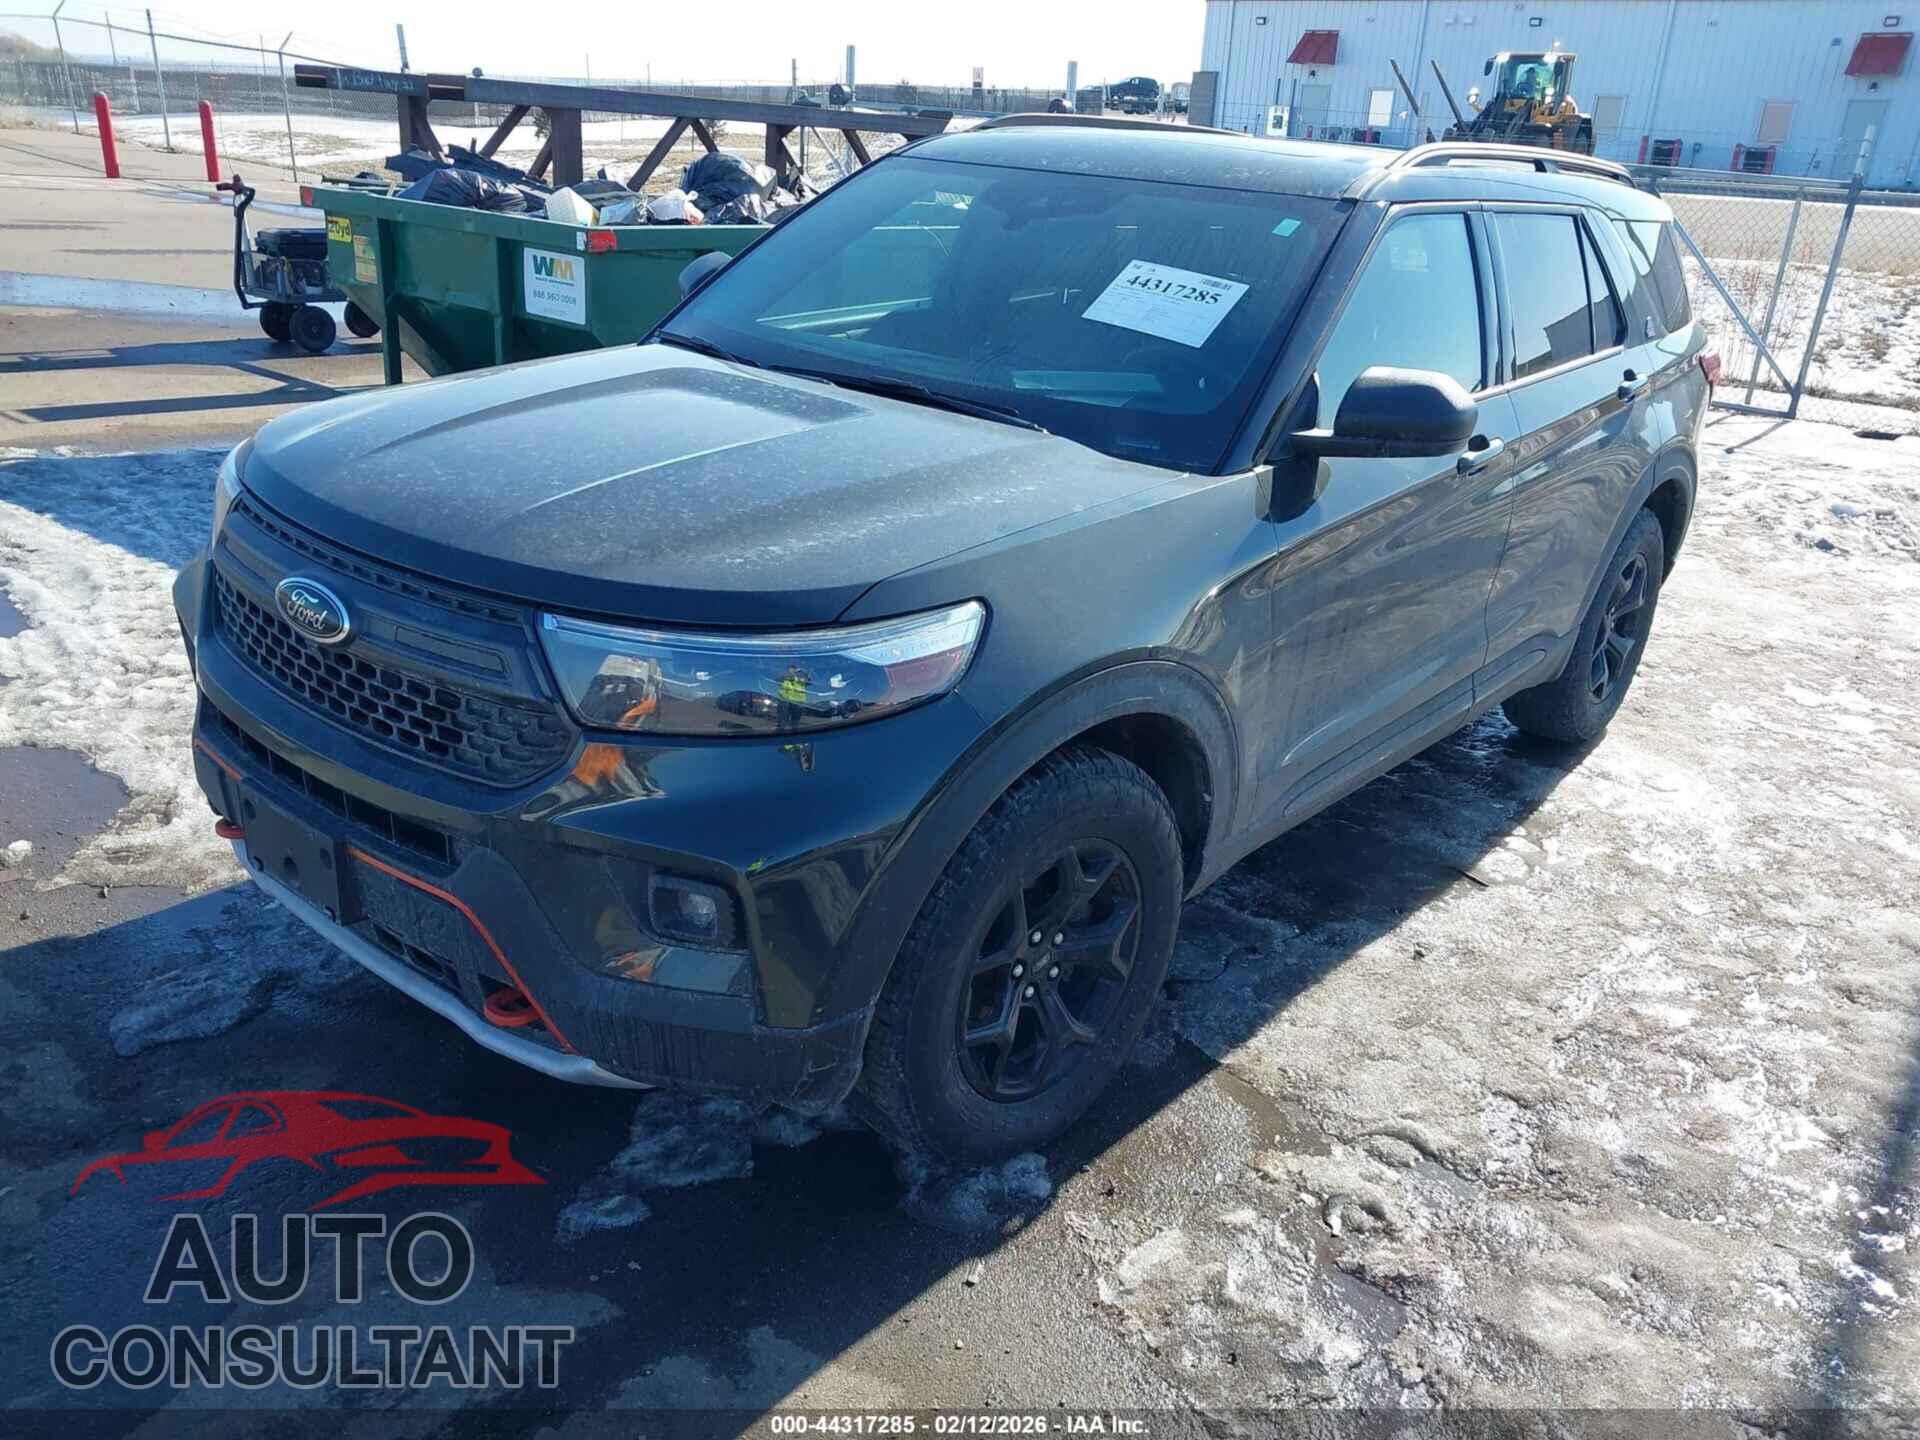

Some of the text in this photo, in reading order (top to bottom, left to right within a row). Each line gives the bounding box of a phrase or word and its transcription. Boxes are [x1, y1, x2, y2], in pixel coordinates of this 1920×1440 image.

[329, 223, 351, 238] 20yd
[532, 255, 575, 280] WM
[1126, 275, 1223, 304] 44317285
[287, 589, 328, 630] Ford
